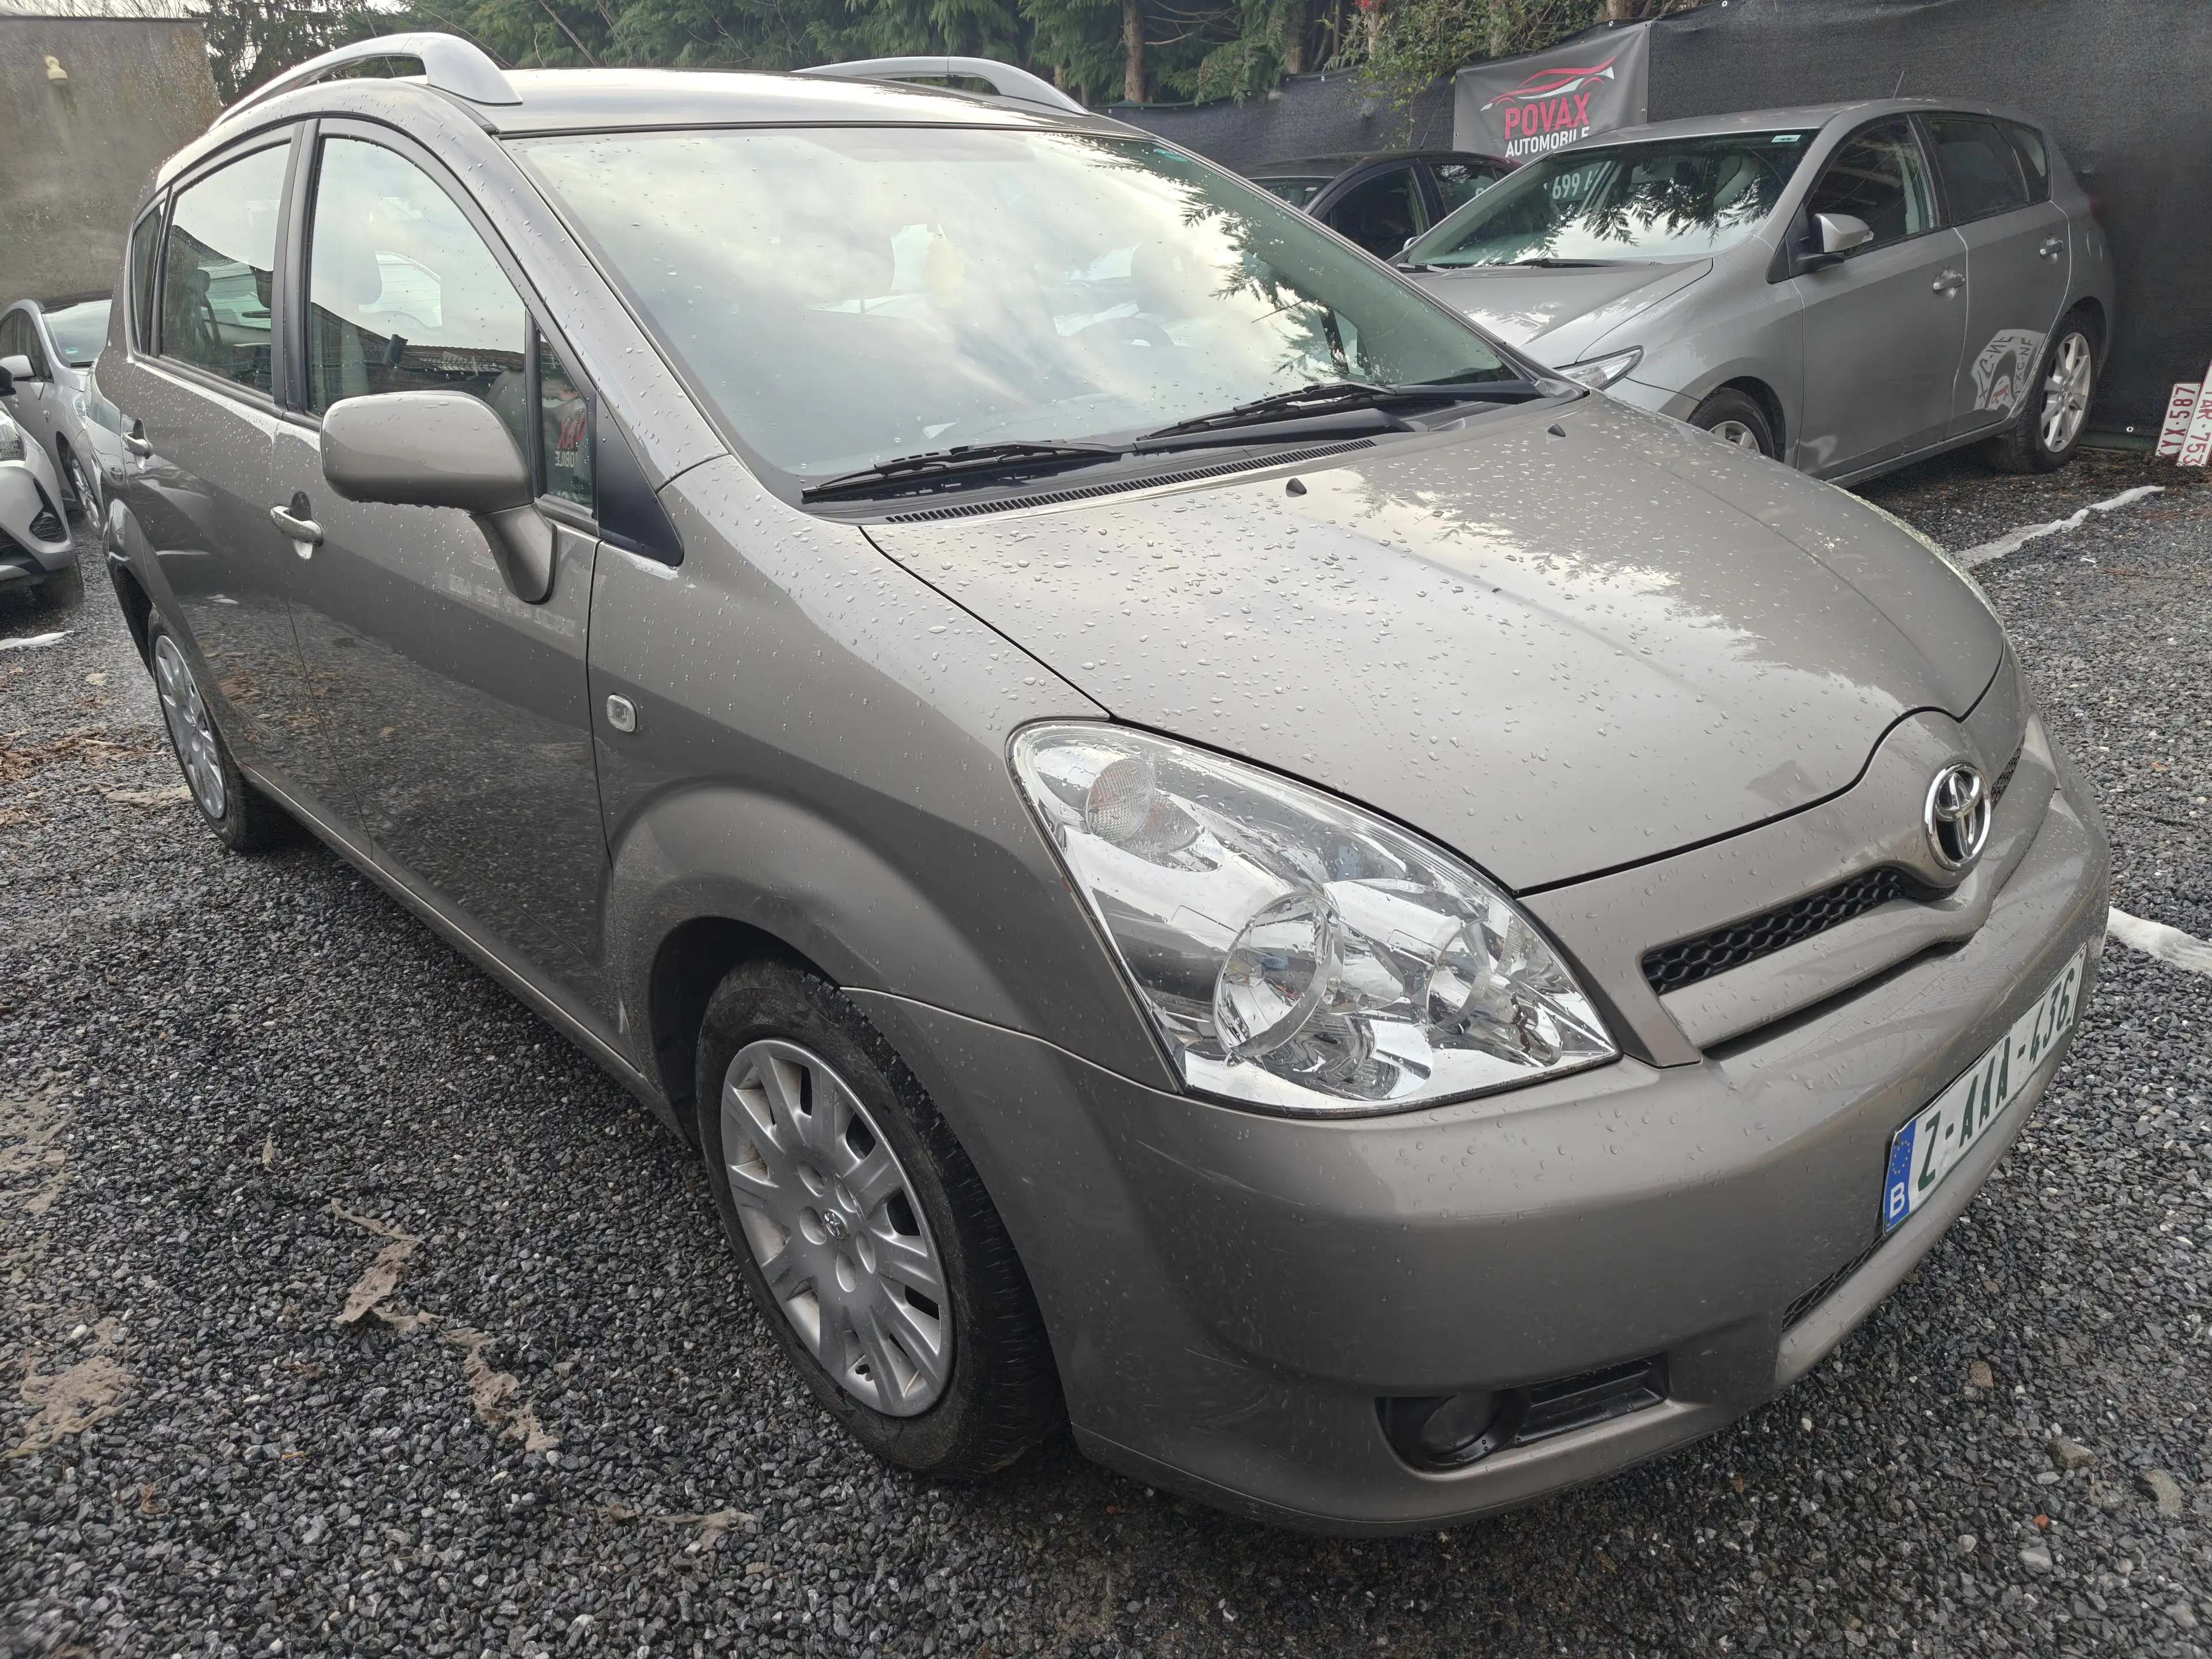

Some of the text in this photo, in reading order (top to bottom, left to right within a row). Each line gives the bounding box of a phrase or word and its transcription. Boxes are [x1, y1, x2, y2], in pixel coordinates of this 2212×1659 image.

[1505, 92, 1589, 139] POVAX
[1505, 126, 1589, 158] AUTOMOBILE
[1918, 967, 2075, 1192] Z-AAA-436
[1889, 1181, 1906, 1218] B
